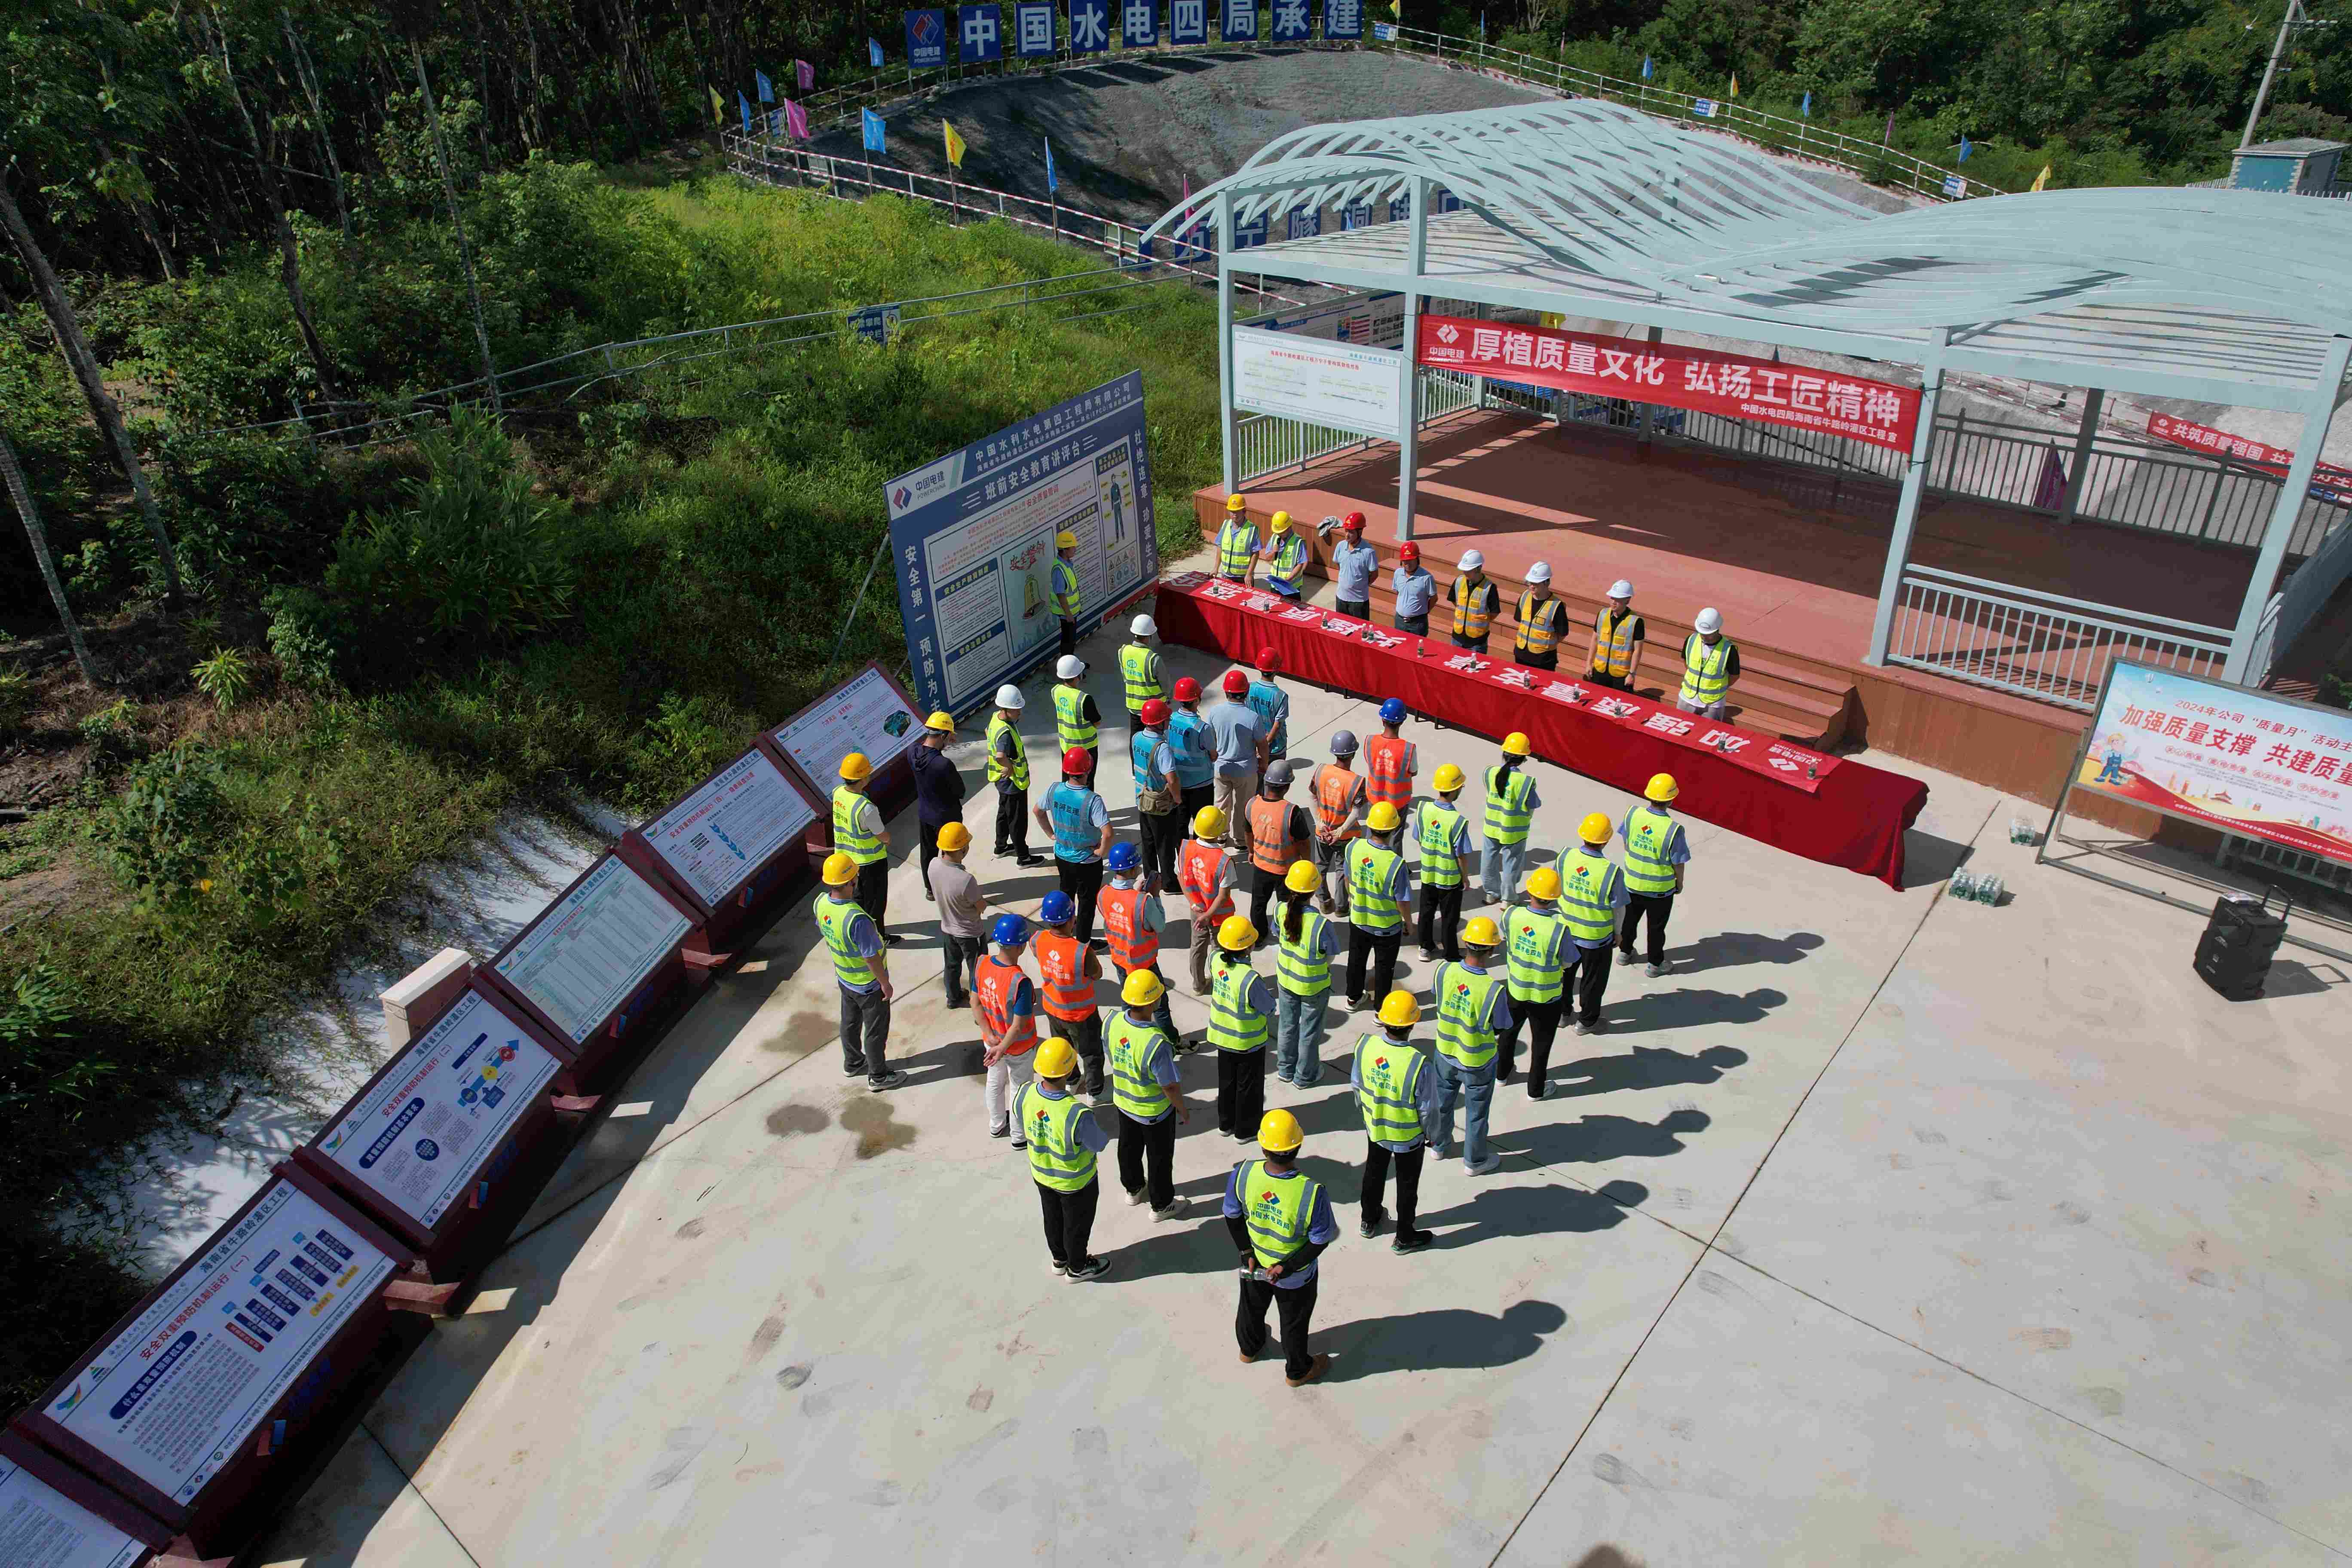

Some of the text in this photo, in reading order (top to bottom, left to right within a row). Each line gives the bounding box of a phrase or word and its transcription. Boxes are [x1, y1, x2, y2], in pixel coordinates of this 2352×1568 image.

[964, 0, 1359, 56] 中国水电四局承建
[1429, 346, 1465, 360] 中国电建
[1471, 327, 1901, 428] 厚植质量文化 弘扬工匠精神
[975, 381, 1131, 463] 中国水利水电第四工程局有限公司
[1741, 402, 1886, 441] 中国水电四局海南省牛路岭灌区工程
[2174, 423, 2264, 459] 共筑质量强国
[914, 470, 945, 492] 中国电建
[916, 482, 946, 500] POWERCHINA
[985, 440, 1081, 501] 班前安全教育讲评台
[1133, 429, 1155, 576] 杜绝违章 珍爱生命
[904, 545, 926, 623] 安全第一
[1444, 654, 1751, 754] 加强质量支撑
[2119, 704, 2257, 756] 加强质量支撑
[2174, 699, 2245, 724] 2024年公司
[1053, 801, 1080, 816] 黄河监理
[1518, 935, 1537, 946] 中国电建
[413, 994, 476, 1057] 海南省牛路岭灌区工程
[379, 1042, 453, 1118] 安全双重预防机制运行（二）
[1032, 1120, 1053, 1134] 中国电建
[197, 1186, 289, 1274] 海南省牛路岭灌区工程
[1251, 1210, 1291, 1231] 中国水电四局
[1257, 1202, 1283, 1217] 中国电建
[137, 1251, 251, 1362] 安全双重预防机制运行（一）
[119, 1340, 188, 1408] 什么是双重预防机制
